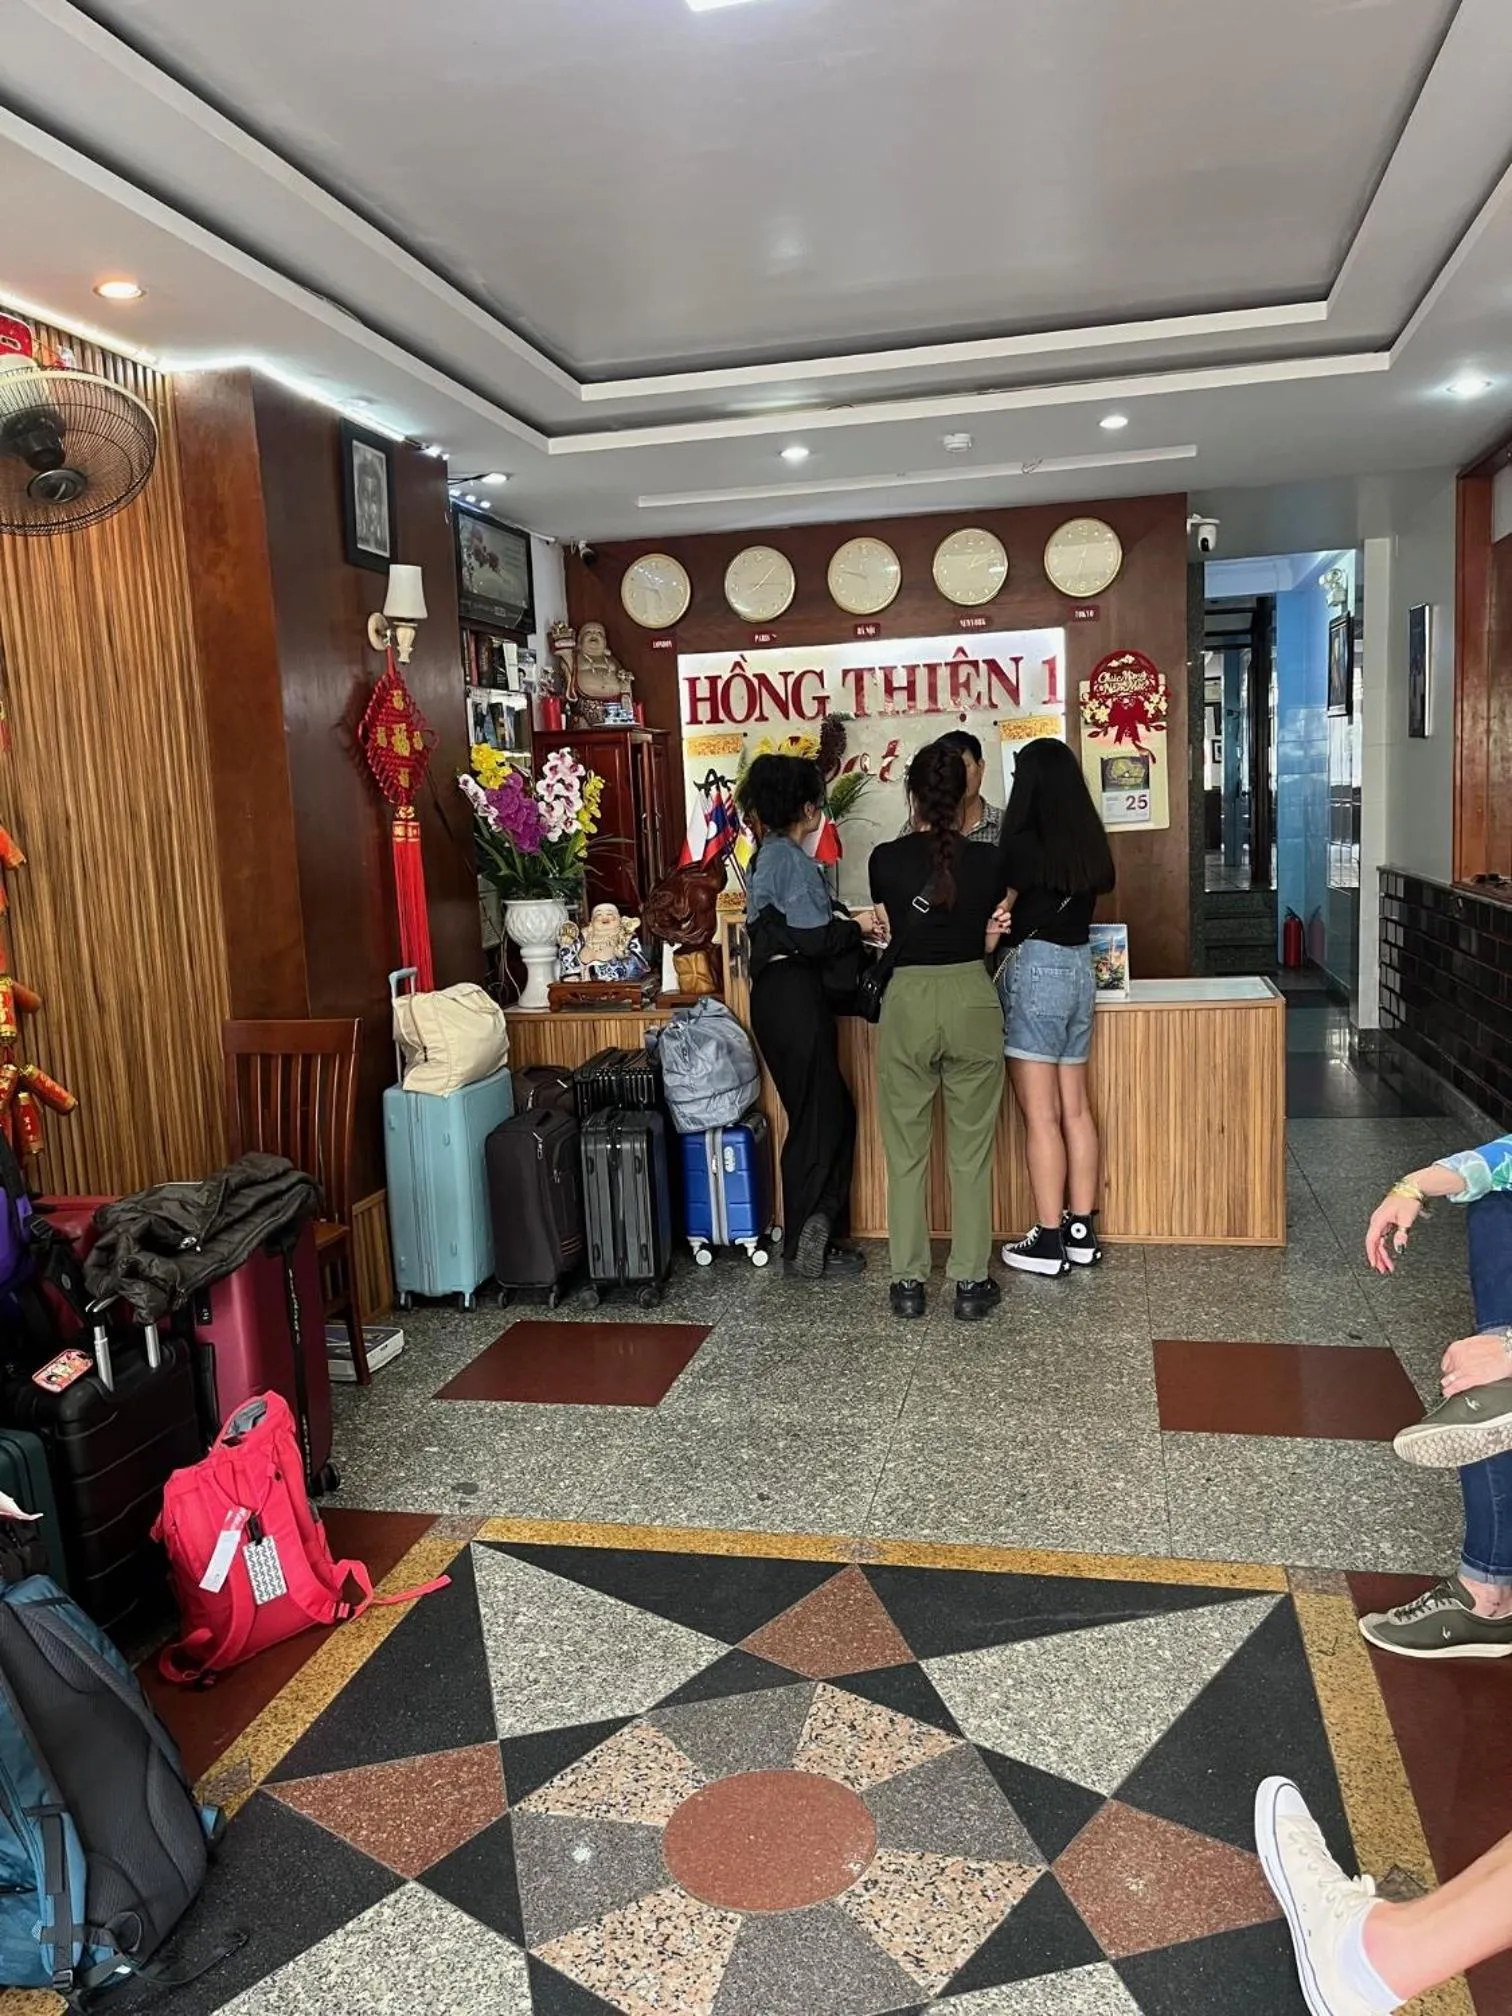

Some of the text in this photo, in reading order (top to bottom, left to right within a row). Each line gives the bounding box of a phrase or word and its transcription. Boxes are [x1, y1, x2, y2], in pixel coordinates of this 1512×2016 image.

[683, 654, 830, 725] HỒNG
[1042, 655, 1063, 705] 1
[1125, 794, 1148, 811] 25
